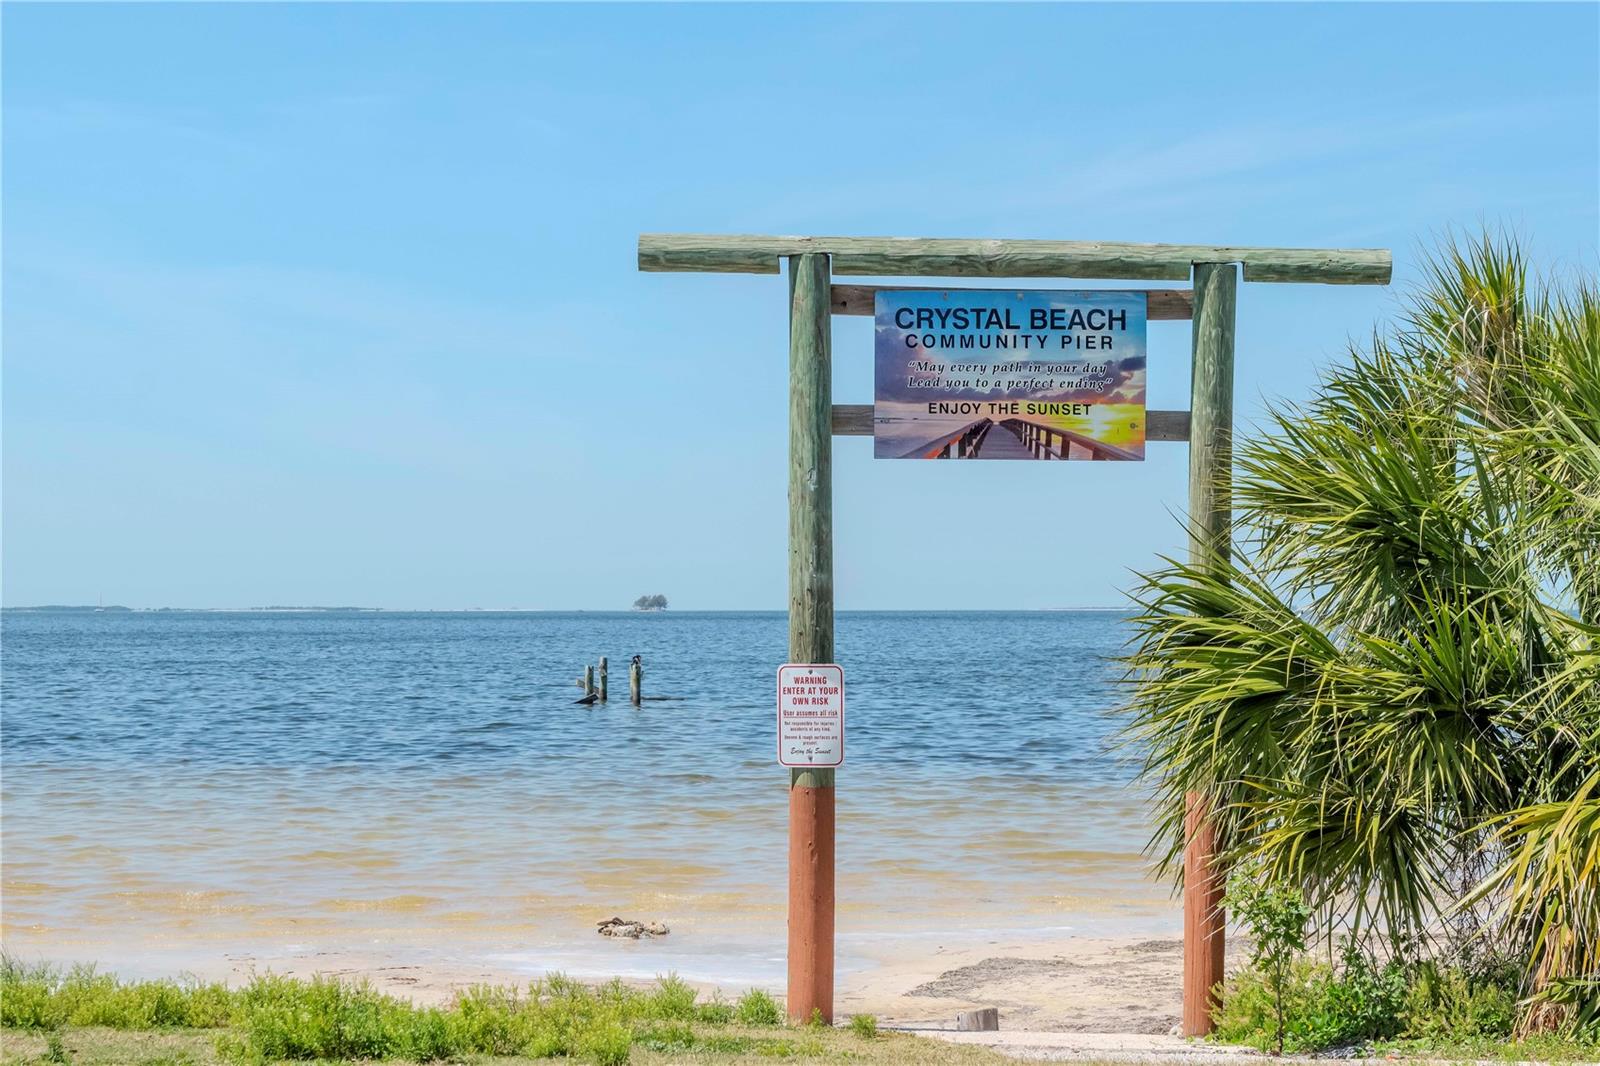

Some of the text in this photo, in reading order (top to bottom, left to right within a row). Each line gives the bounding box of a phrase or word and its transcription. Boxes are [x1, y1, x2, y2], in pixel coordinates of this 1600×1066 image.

[895, 307, 1126, 331] CRYSTAL BEACH
[905, 334, 1113, 350] COMMUNITY PIER
[950, 364, 987, 375] every
[992, 362, 1023, 374] path
[1028, 362, 1041, 373] in
[1047, 364, 1077, 375] your
[1082, 363, 1107, 375] day
[907, 377, 940, 388] Lead
[946, 379, 970, 390] you
[975, 378, 989, 388] to
[994, 379, 1002, 388] a
[1007, 378, 1054, 391] perfect
[928, 403, 1092, 416] ENJOY THE SUNSET
[793, 676, 827, 684] WARNING
[792, 697, 828, 705] OWN RISK
